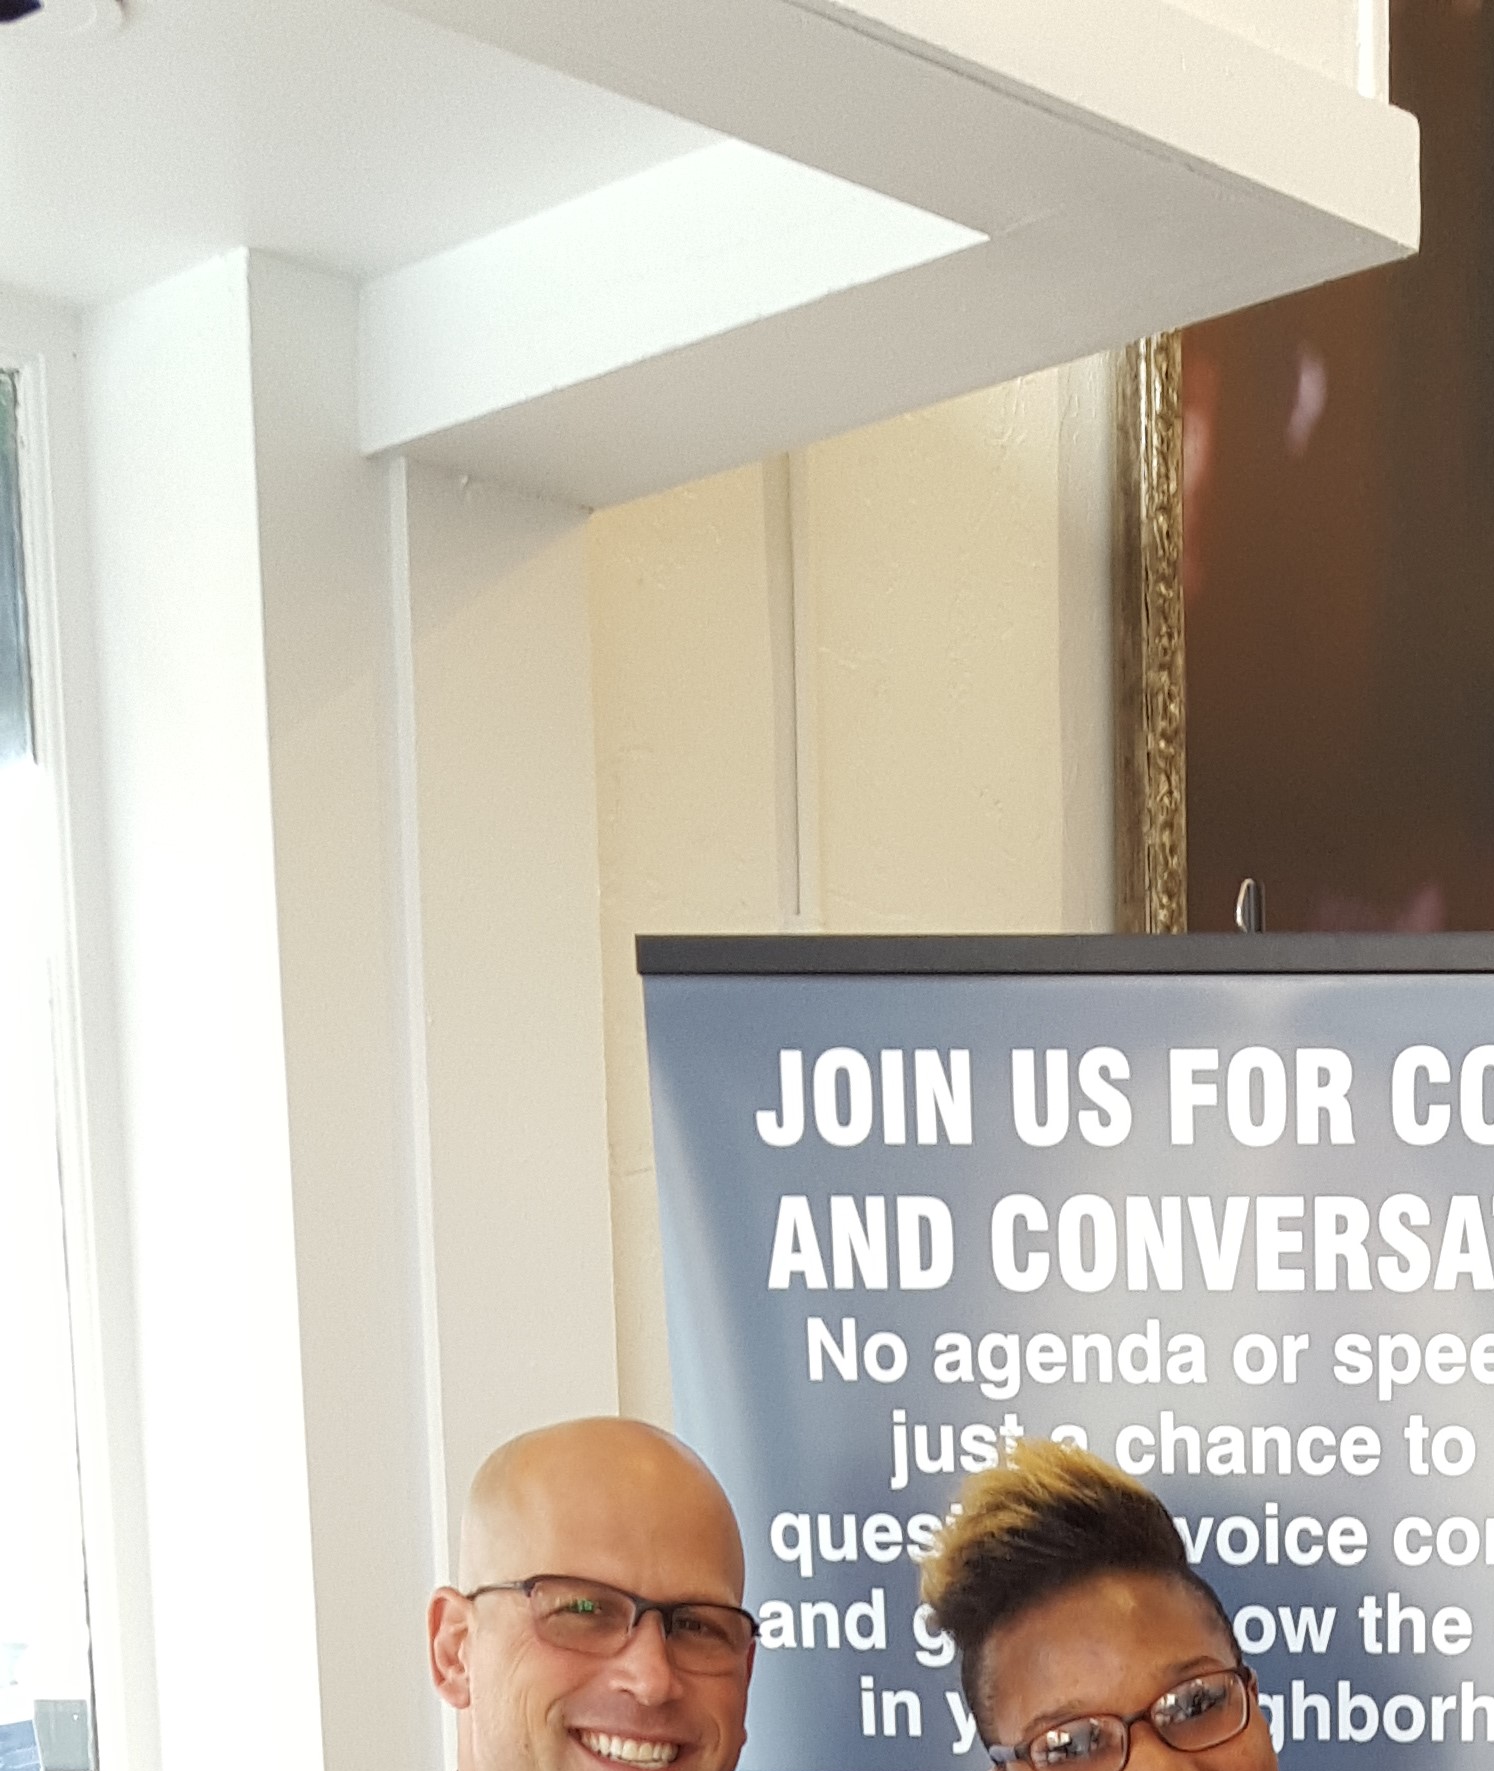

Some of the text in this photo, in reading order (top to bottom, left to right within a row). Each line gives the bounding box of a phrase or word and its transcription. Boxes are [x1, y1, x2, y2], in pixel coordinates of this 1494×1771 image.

[757, 1048, 972, 1146] JOIN
[1013, 1047, 1131, 1146] US
[1170, 1047, 1355, 1146] FOR
[769, 1196, 953, 1289] AND
[808, 1318, 907, 1382] No
[935, 1319, 1207, 1399] agenda
[1234, 1334, 1308, 1384] or
[891, 1409, 1024, 1490] just
[1117, 1412, 1381, 1477] chance
[1404, 1415, 1475, 1475] to
[1173, 1502, 1368, 1567] voice
[759, 1587, 887, 1651] and
[1233, 1604, 1337, 1655] ow
[1359, 1593, 1472, 1655] the
[860, 1675, 922, 1738] in
